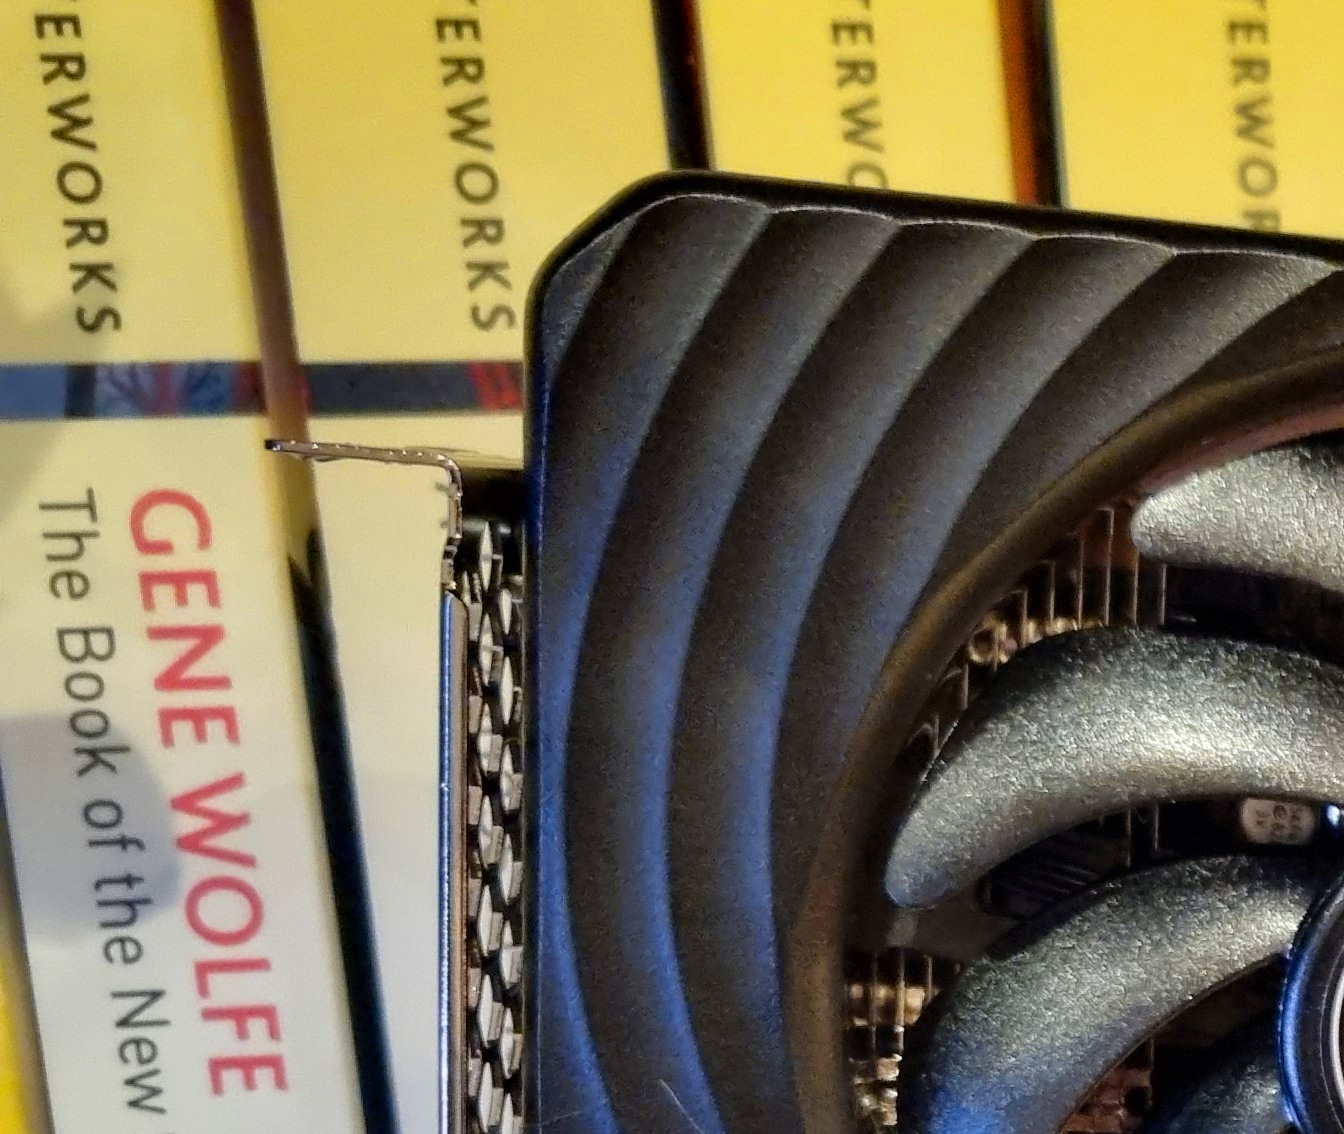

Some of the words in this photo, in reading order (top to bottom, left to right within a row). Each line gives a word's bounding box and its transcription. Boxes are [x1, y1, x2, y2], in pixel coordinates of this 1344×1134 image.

[34, 0, 122, 333] ERWORKS
[434, 0, 516, 331] ERWORKS
[39, 487, 100, 600] The
[130, 488, 241, 748] GENE
[57, 626, 132, 777] Book
[84, 800, 146, 853] of
[94, 872, 154, 965] the
[170, 772, 290, 1097] WOLFE
[111, 988, 172, 1116] New
